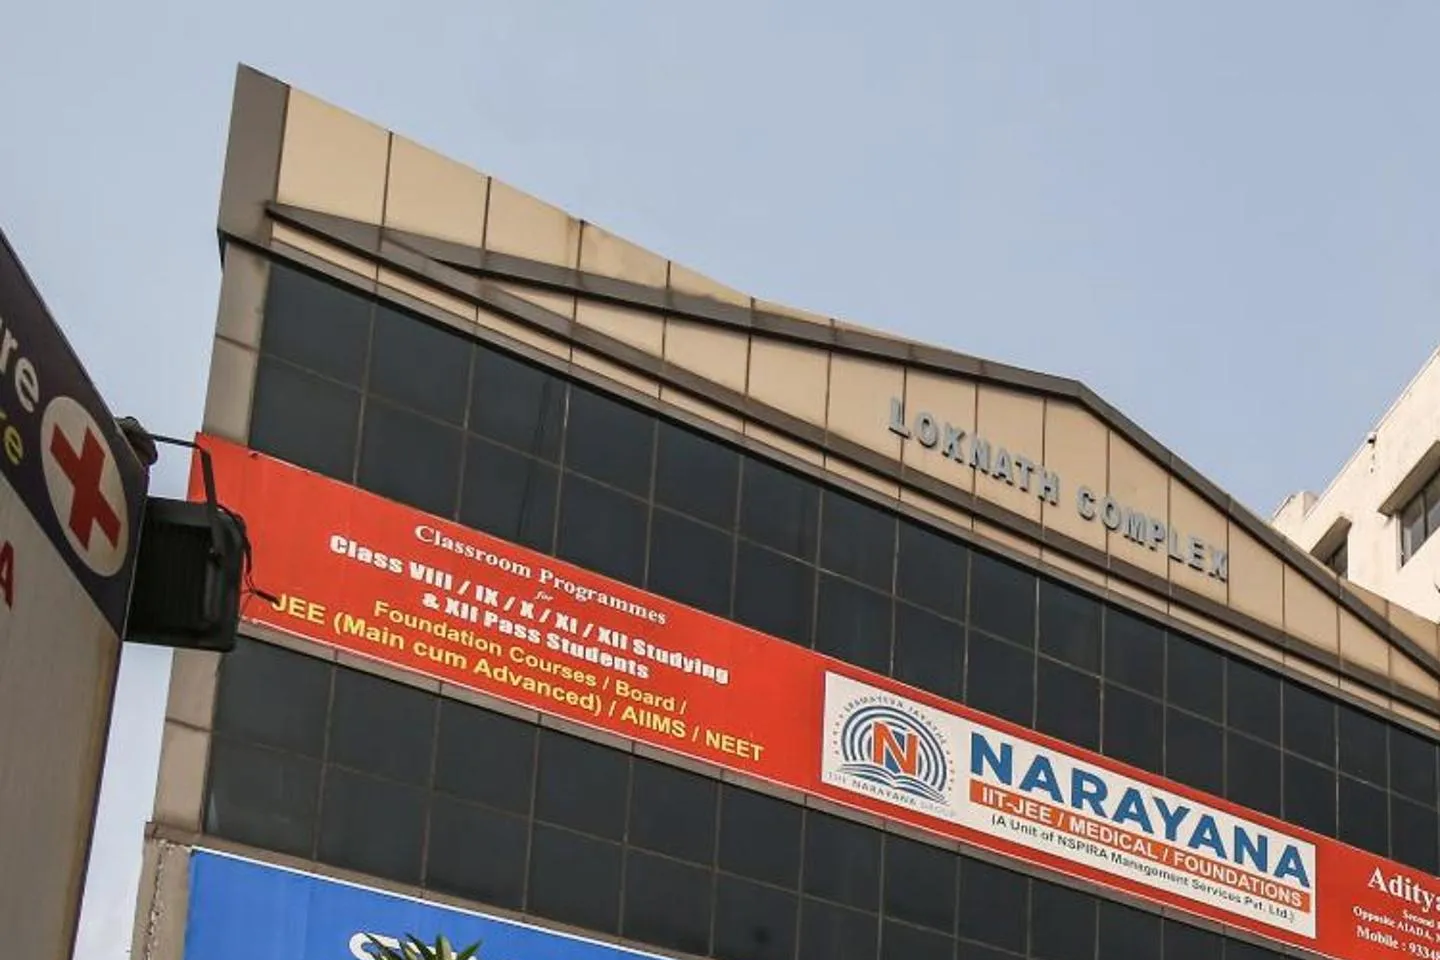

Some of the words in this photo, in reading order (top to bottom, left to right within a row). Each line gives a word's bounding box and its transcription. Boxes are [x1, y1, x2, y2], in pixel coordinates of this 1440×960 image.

[889, 397, 1060, 506] LOKNATH
[1076, 484, 1229, 583] COMPLEX
[330, 535, 403, 574] Class
[409, 561, 452, 591] VIII
[458, 581, 471, 596] /
[475, 584, 498, 608] IX
[503, 597, 516, 612] /
[520, 601, 535, 619] X
[539, 608, 551, 623] /
[555, 612, 578, 634] XI
[583, 624, 594, 639] /
[598, 627, 628, 649] XII
[633, 638, 729, 685] Studying
[414, 525, 532, 579] Classroom
[539, 567, 667, 625] Programmes
[535, 590, 554, 602] for
[271, 594, 326, 625] JEE
[333, 611, 404, 650] (Main
[413, 641, 468, 669] cum
[473, 657, 602, 717] Advanced)
[608, 700, 617, 717] /
[620, 705, 687, 739] AIIMS
[692, 726, 700, 742] /
[705, 729, 764, 761] NEET
[374, 600, 502, 657] Foundation
[509, 646, 597, 687] Courses
[602, 676, 610, 691] /
[615, 678, 676, 712] Board
[680, 699, 688, 715] /
[422, 593, 440, 610] &
[445, 598, 478, 624] XII
[484, 610, 541, 645] Pass
[546, 632, 650, 680] Students
[970, 731, 1310, 888] NARAYANA
[983, 786, 1052, 822] IIT-JEE
[1055, 808, 1064, 827] /
[1069, 816, 1159, 861] MEDICAL
[1162, 845, 1171, 863] /
[1173, 849, 1302, 908] FOUNDATIONS
[1010, 819, 1037, 838] Unit
[1042, 828, 1055, 843] of
[1057, 836, 1108, 859] NSPIRA
[1110, 852, 1189, 888] Management
[1191, 877, 1241, 905] Services
[1244, 895, 1266, 912] Pvt.
[1356, 925, 1399, 949] Mobile
